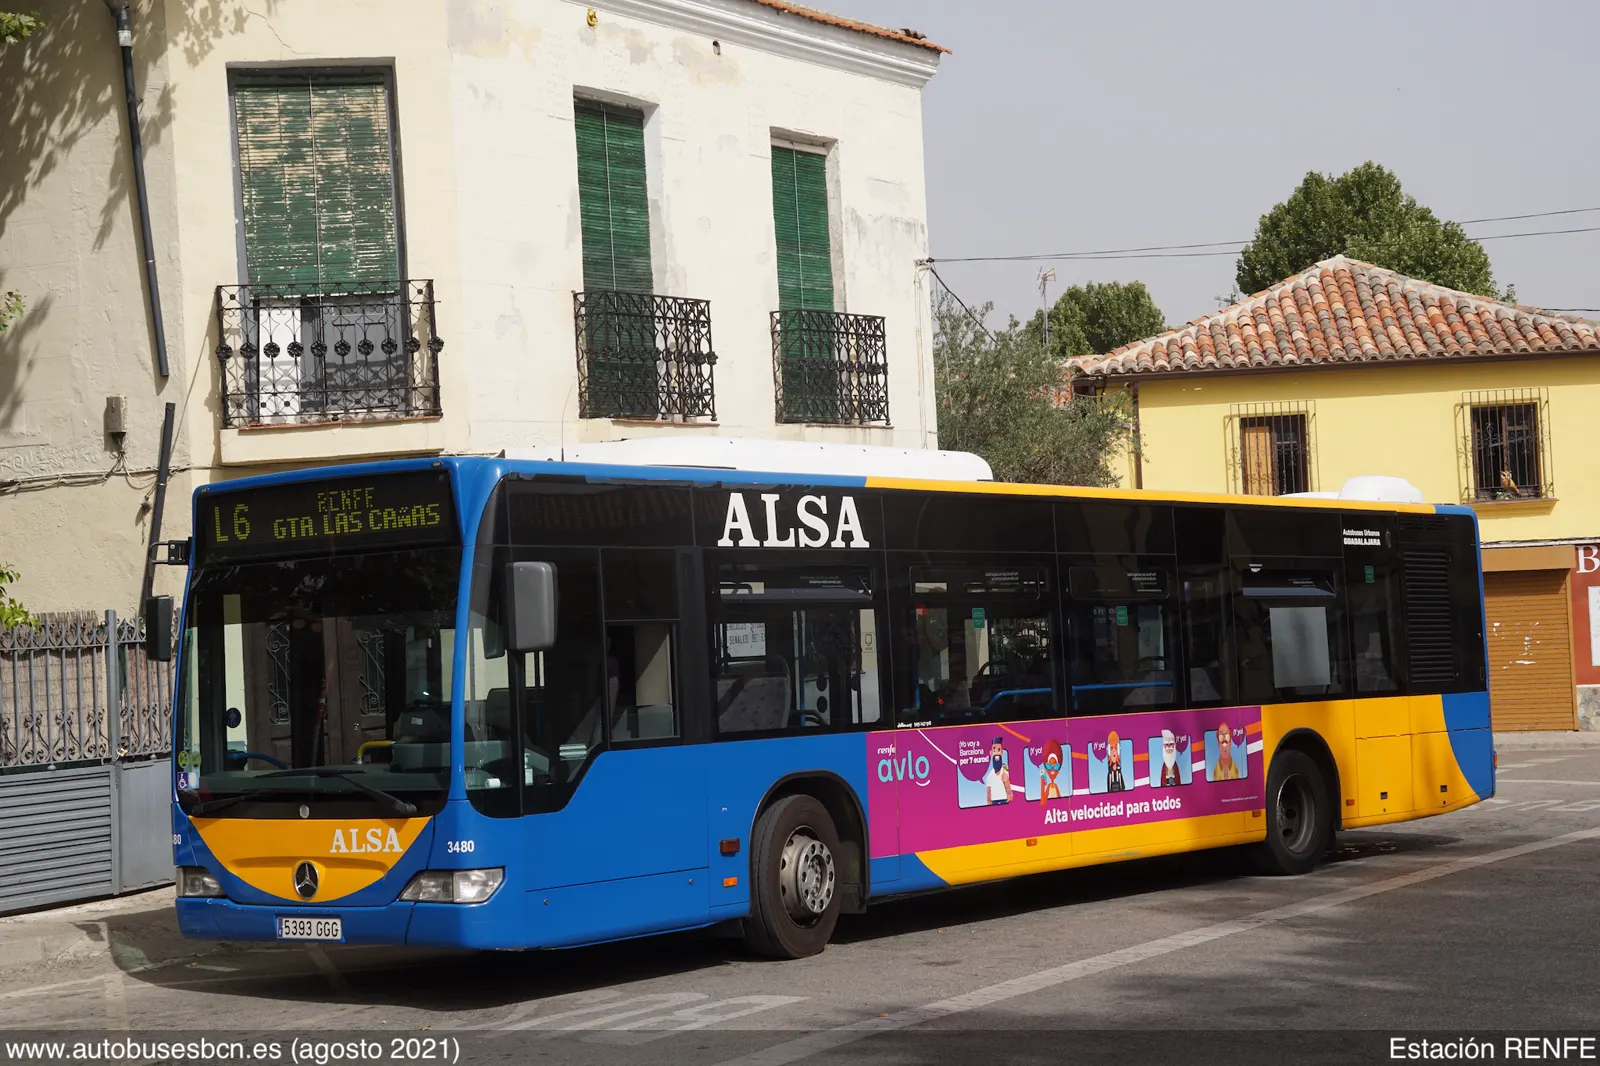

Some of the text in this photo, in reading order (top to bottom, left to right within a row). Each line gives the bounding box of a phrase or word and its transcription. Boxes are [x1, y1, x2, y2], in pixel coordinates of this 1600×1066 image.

[273, 516, 318, 540] GTA.
[323, 511, 363, 535] LAS
[717, 492, 870, 548] ALSA
[1342, 528, 1381, 537] Autobuses Urbanos
[1343, 537, 1381, 546] GUADALAJARA
[877, 744, 897, 757] renfe
[959, 749, 984, 757] Barcelona
[877, 751, 930, 783] avlo
[959, 758, 968, 766] por
[1044, 796, 1181, 824] Alta velocidad para todos
[329, 828, 403, 853] ALSA
[447, 840, 475, 853] 3480
[284, 919, 339, 937] 5393 GGG
